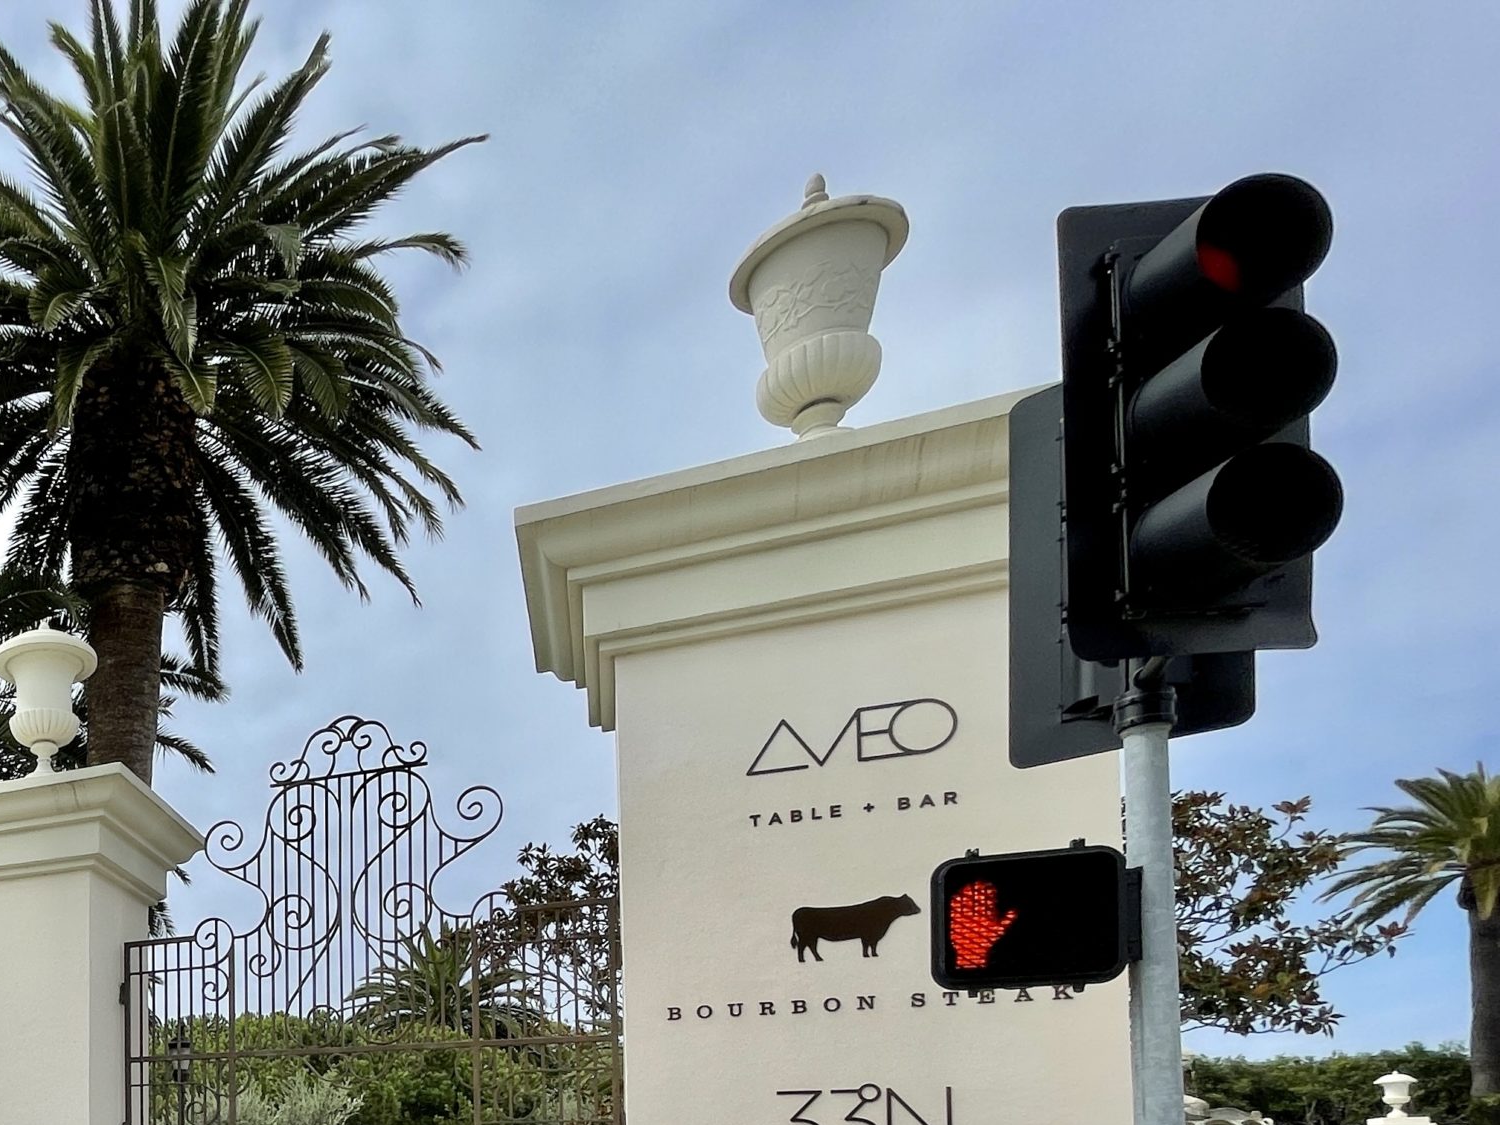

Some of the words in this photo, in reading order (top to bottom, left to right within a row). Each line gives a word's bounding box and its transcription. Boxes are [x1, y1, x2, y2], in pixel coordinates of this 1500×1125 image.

[749, 804, 842, 827] TABLE
[863, 802, 875, 813] +
[896, 791, 958, 811] BAR
[667, 995, 876, 1021] BOURBON
[910, 985, 1074, 1008] STEAK
